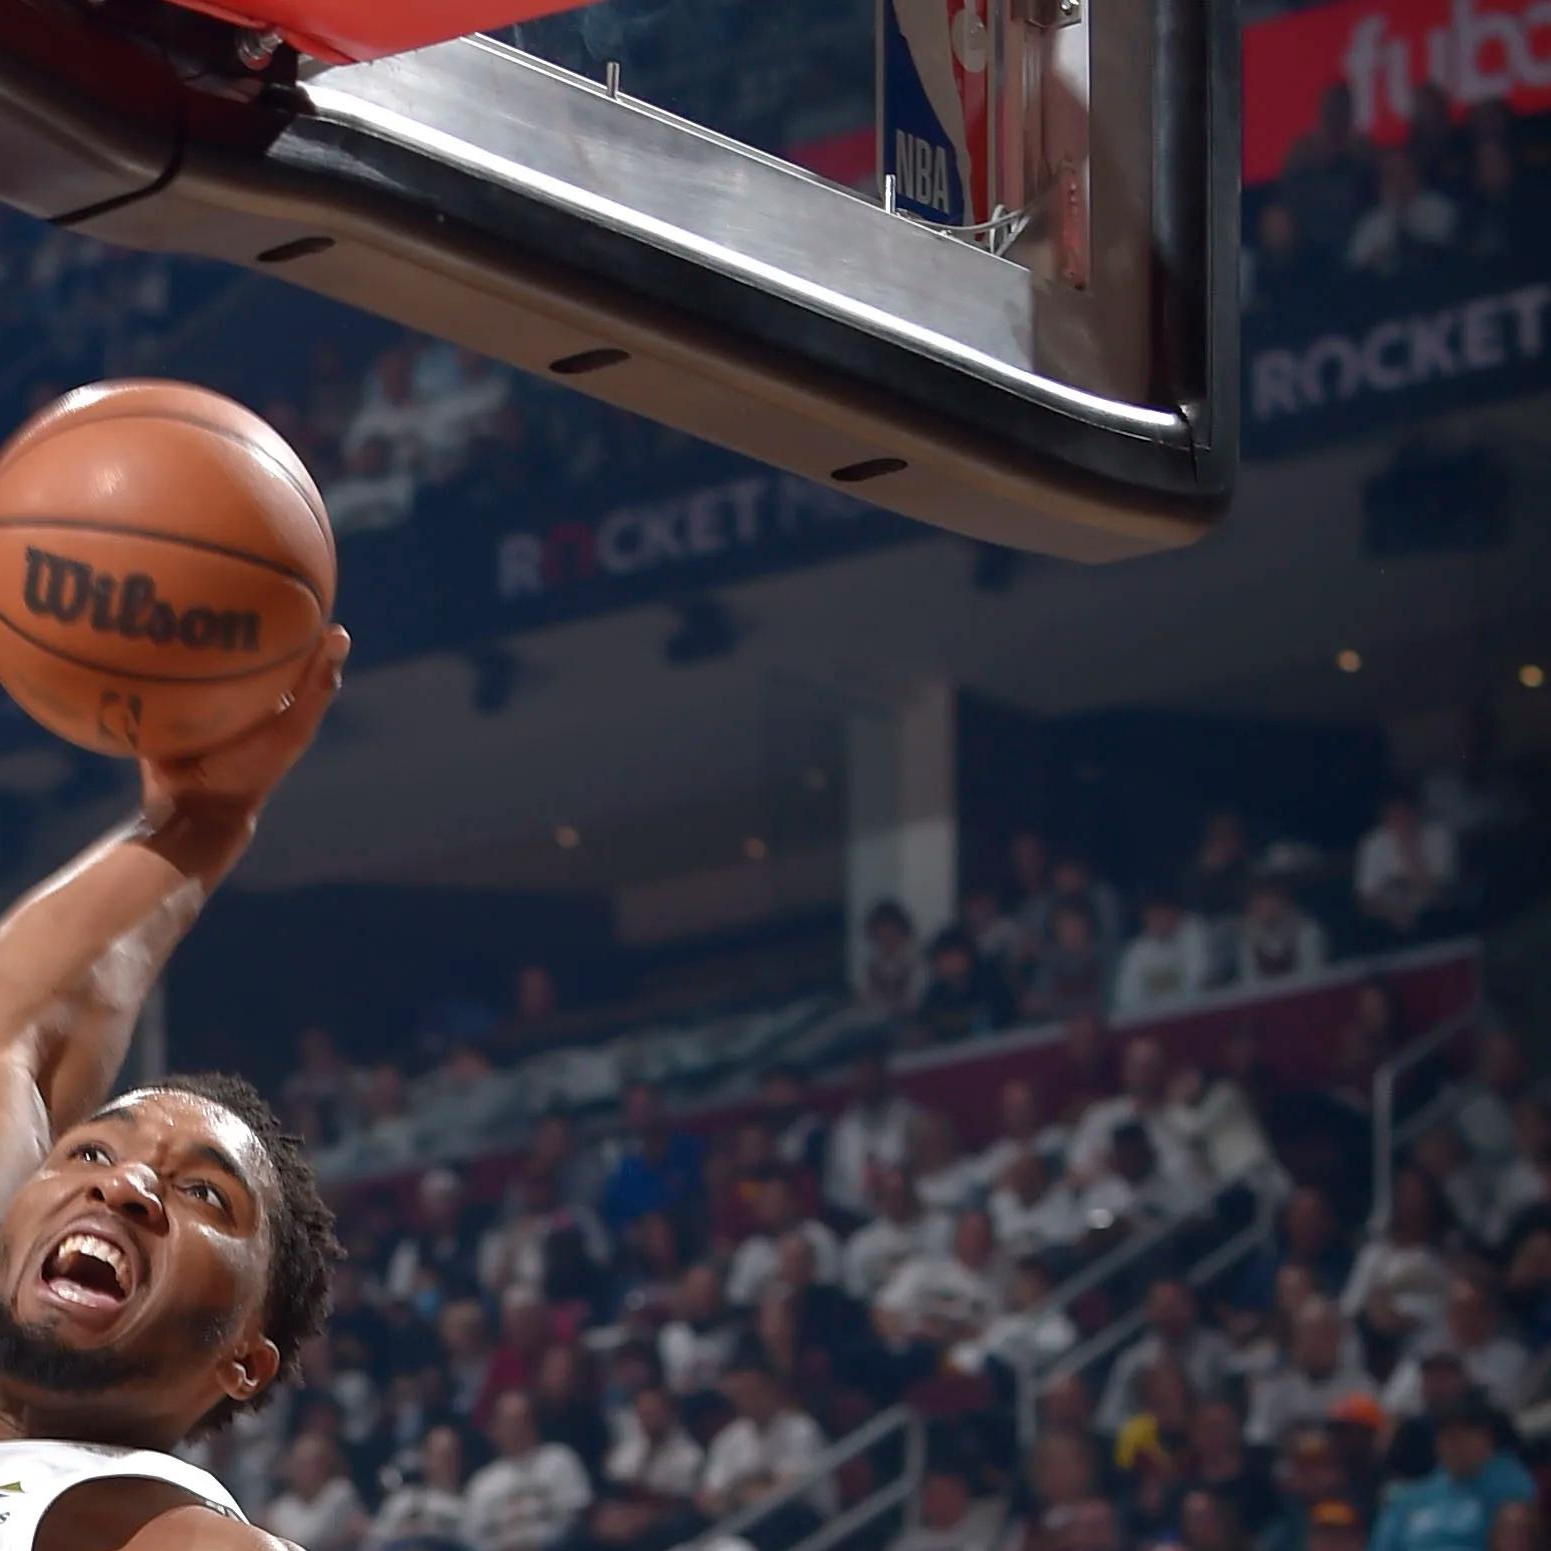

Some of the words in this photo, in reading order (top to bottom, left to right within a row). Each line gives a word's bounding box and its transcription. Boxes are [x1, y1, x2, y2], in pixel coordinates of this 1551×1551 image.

[895, 130, 951, 214] NBA
[1251, 283, 1551, 423] ROCKET
[23, 545, 261, 652] Wilson
